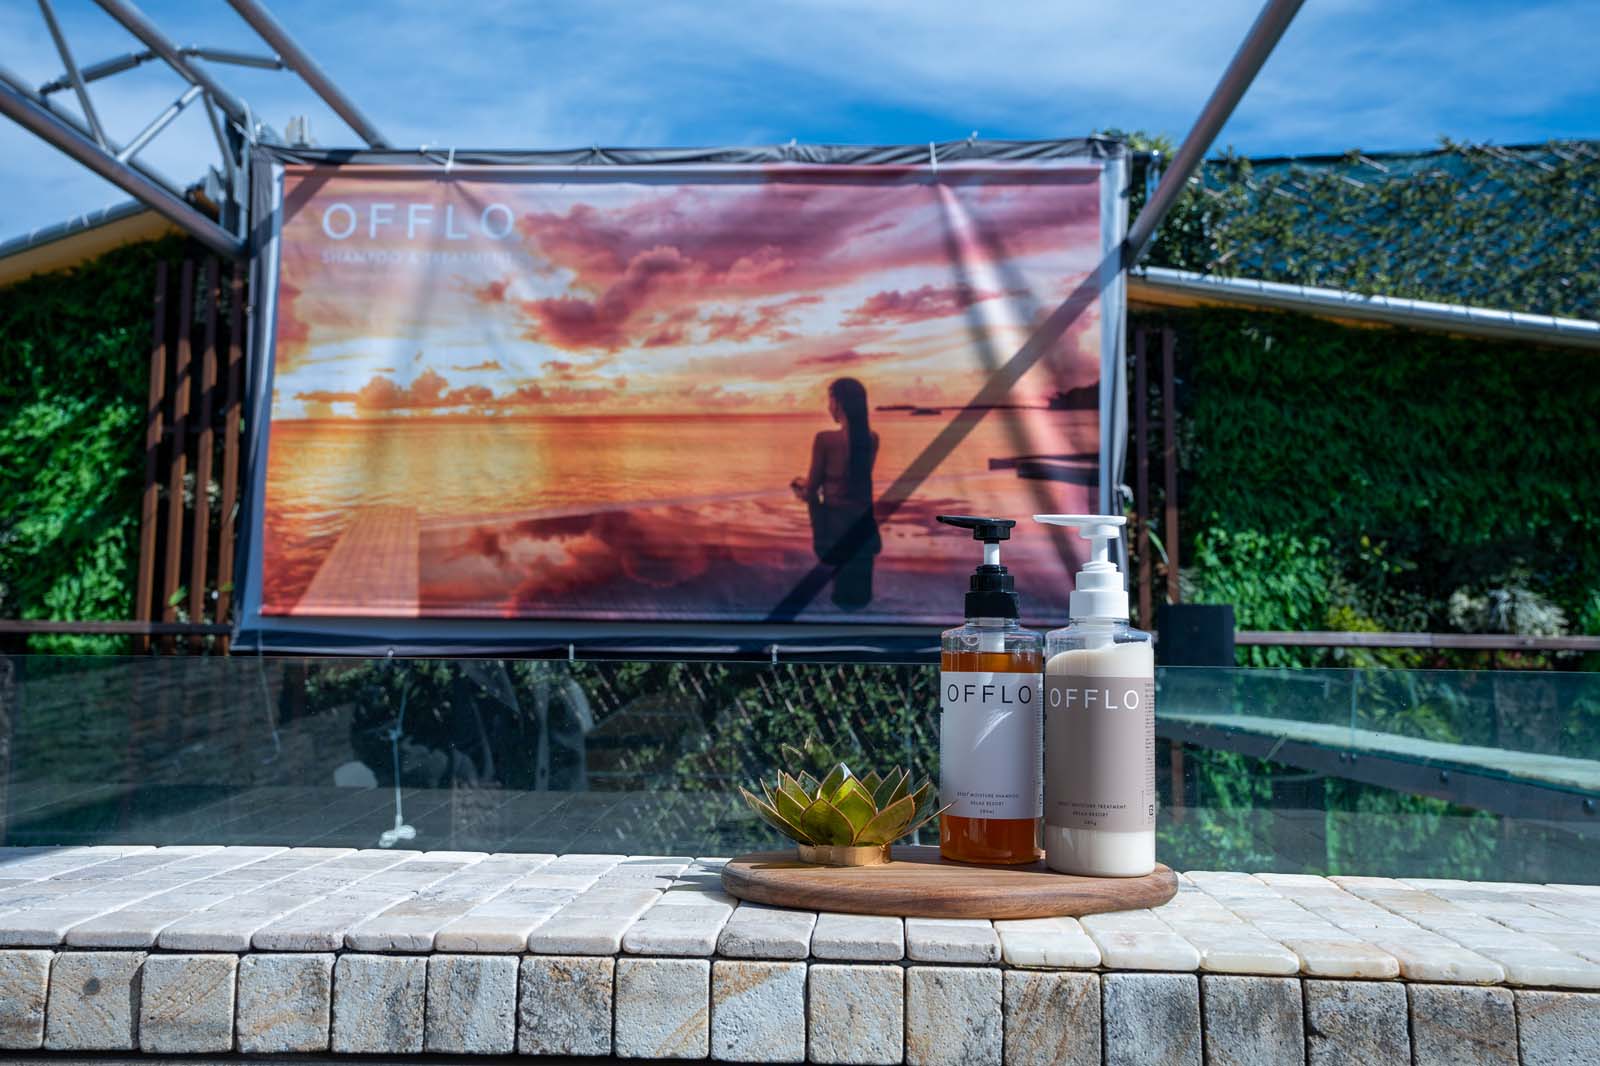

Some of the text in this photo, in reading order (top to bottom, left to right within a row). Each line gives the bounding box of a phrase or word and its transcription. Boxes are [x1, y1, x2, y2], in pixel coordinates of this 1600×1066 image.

[322, 202, 515, 241] OFFLO
[947, 683, 1032, 705] OFFLO
[1049, 687, 1140, 711] OFFLO
